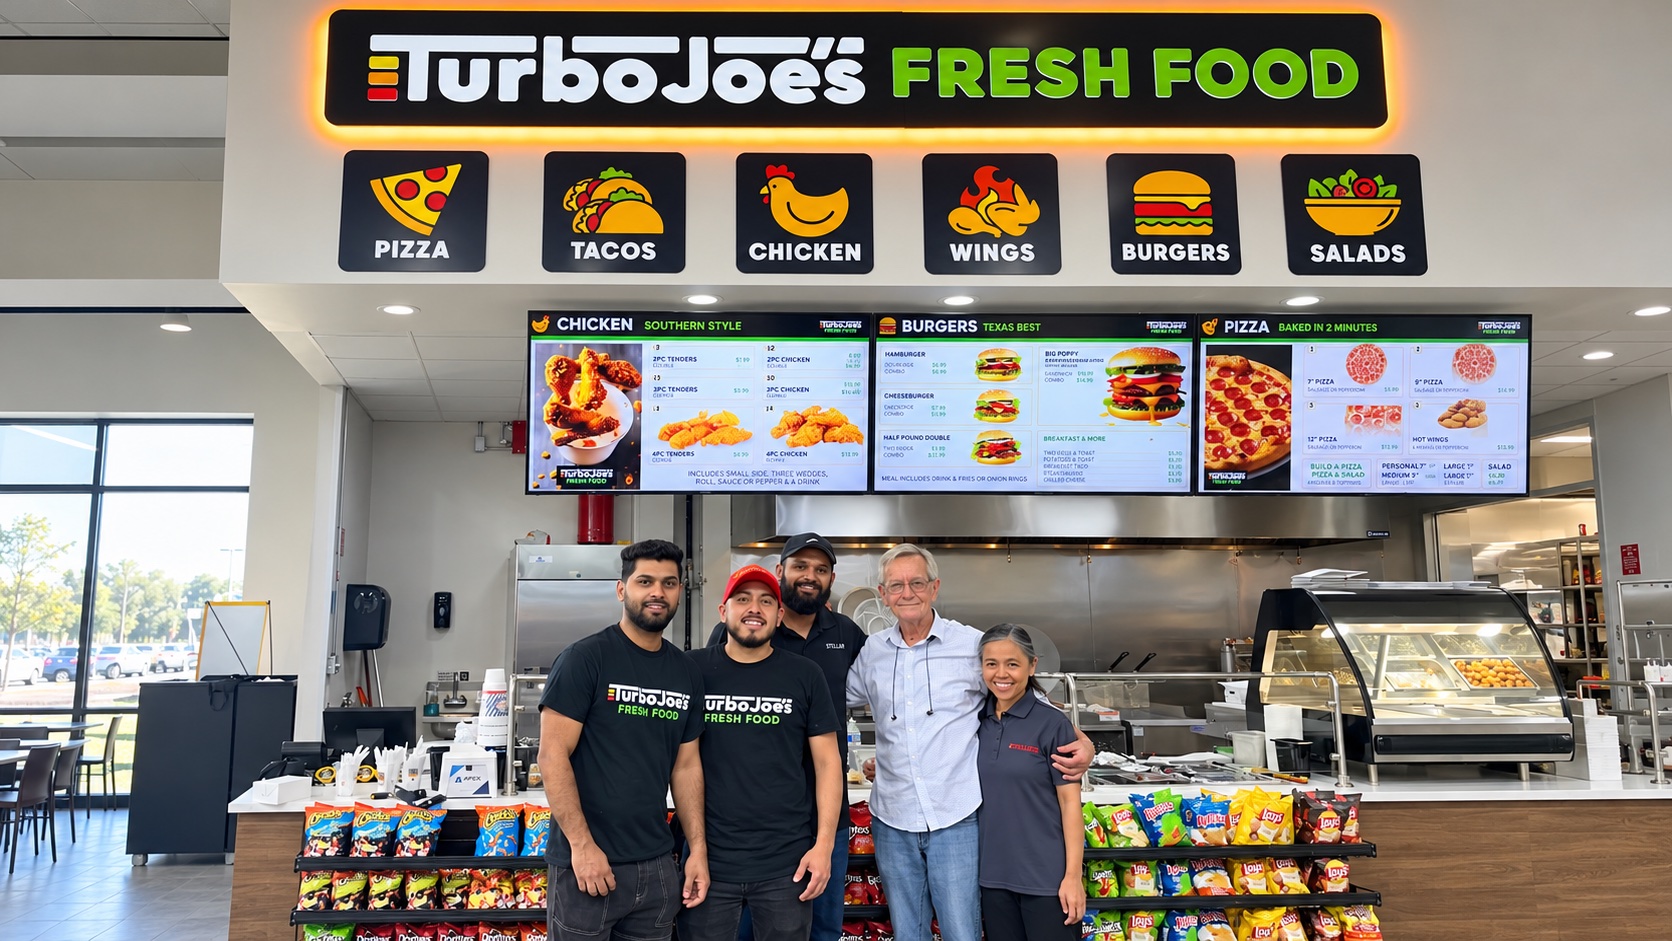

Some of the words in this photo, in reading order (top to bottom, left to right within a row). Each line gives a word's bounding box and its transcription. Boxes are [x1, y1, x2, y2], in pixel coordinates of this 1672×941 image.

[892, 47, 1128, 99] FRESH
[1154, 47, 1361, 101] FOOD
[373, 240, 450, 260] PIZZA
[570, 241, 656, 261] TACOS
[747, 242, 862, 262] CHICKEN
[949, 242, 1036, 262] WINGS
[1121, 242, 1231, 262] BURGERS
[1309, 243, 1407, 263] SALADS
[557, 317, 633, 331] CHICKEN
[644, 321, 705, 331] SOUTHERN
[708, 321, 742, 331] STYLE
[902, 320, 978, 333] BURGERS
[983, 323, 1014, 331] TEXAS
[1017, 323, 1041, 331] BEST
[1225, 320, 1270, 333] PIZZA
[1279, 323, 1312, 332] BAKED
[1313, 323, 1324, 332] IN
[1325, 323, 1332, 332] 2
[1334, 323, 1378, 332] MINUTES
[608, 683, 691, 711] TurboJoe's
[703, 694, 793, 715] urboJoe's
[617, 704, 649, 717] FRESH
[651, 707, 679, 721] FOOD
[704, 713, 742, 724] FRESH
[745, 714, 780, 725] FOOD
